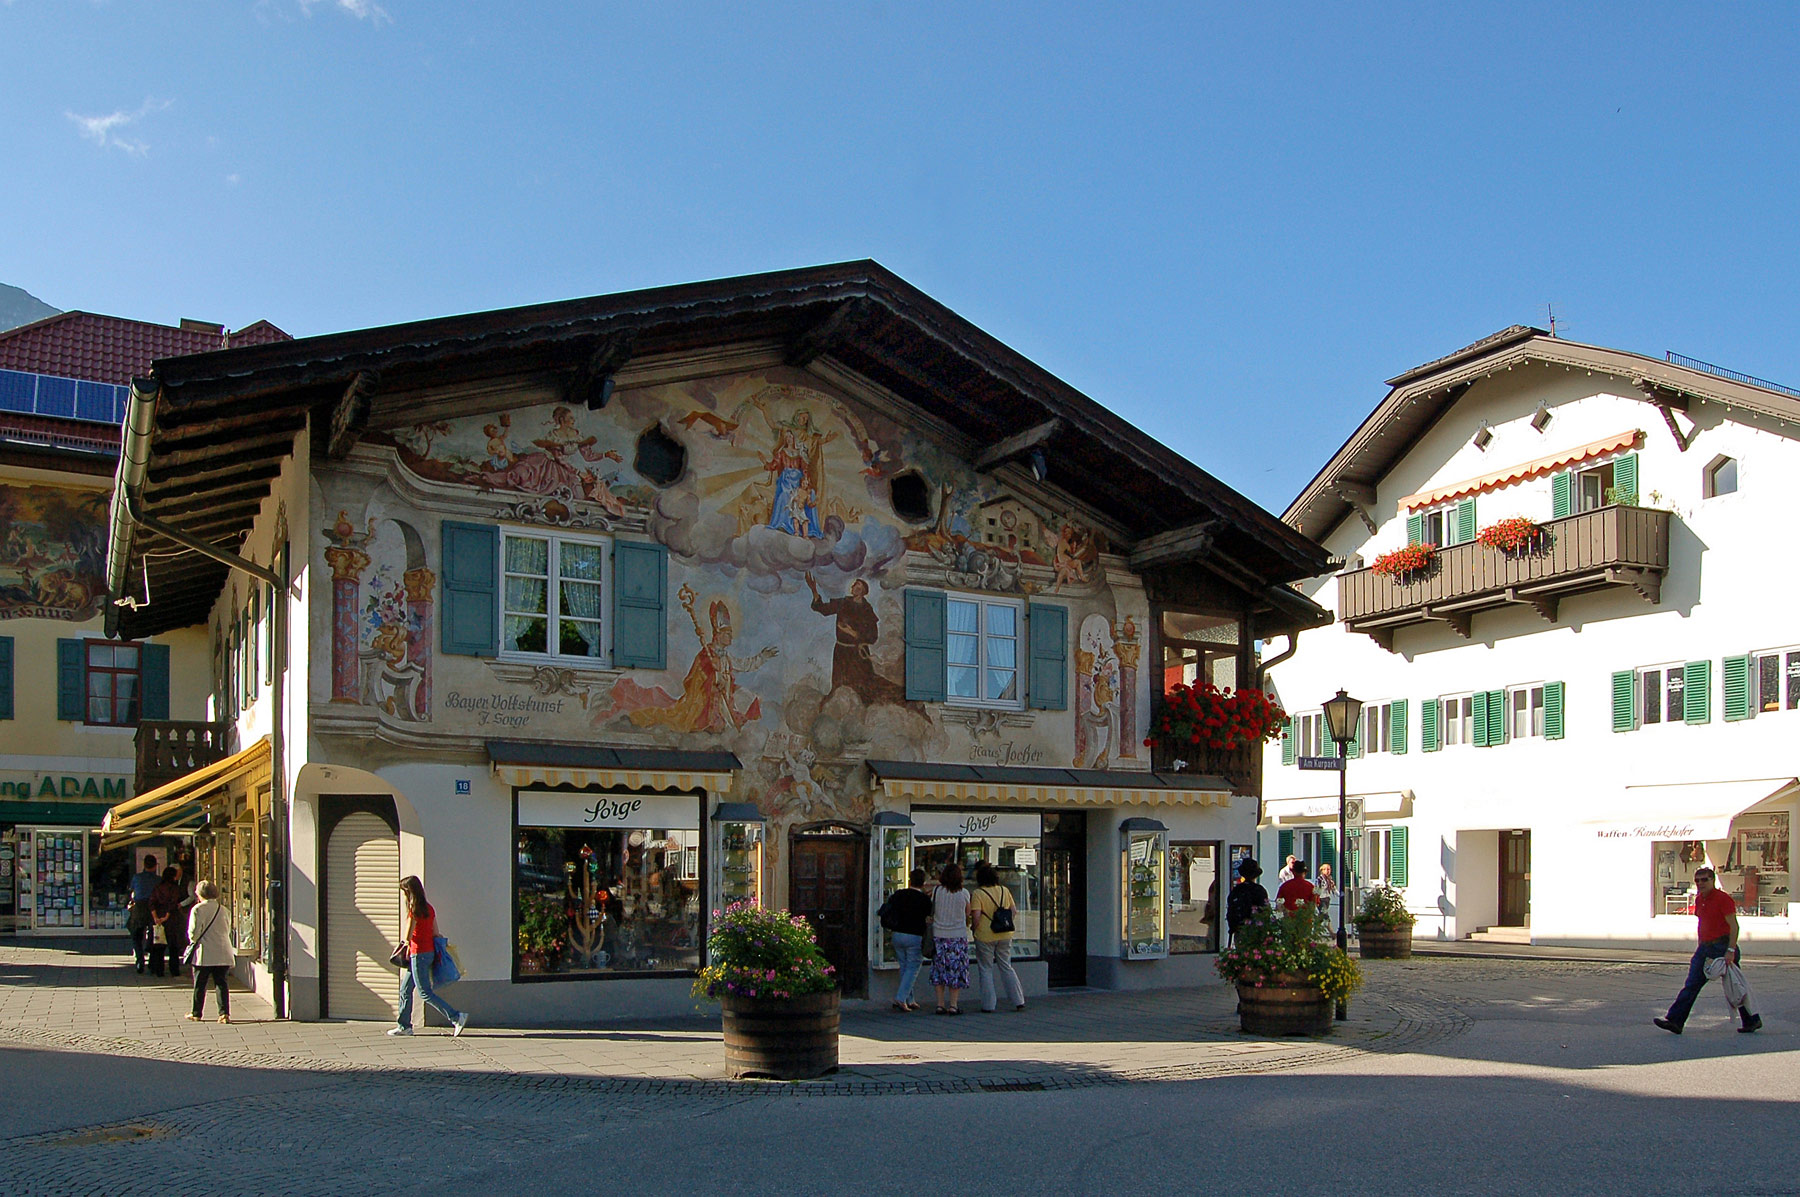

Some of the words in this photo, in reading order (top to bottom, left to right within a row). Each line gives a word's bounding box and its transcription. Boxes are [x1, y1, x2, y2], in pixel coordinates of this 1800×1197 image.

[491, 694, 564, 714] Volkskunst
[493, 713, 530, 728] Sorge
[969, 745, 1000, 760] Haus
[996, 741, 1043, 767] Jocher
[1303, 759, 1313, 768] Am
[1314, 759, 1338, 770] Kurpark
[38, 775, 126, 799] ADAM
[458, 782, 469, 790] 18
[584, 798, 641, 823] Sorge
[959, 814, 997, 835] Sorge
[1597, 829, 1628, 839] Waffen
[1632, 824, 1694, 838] Randelzhofer
